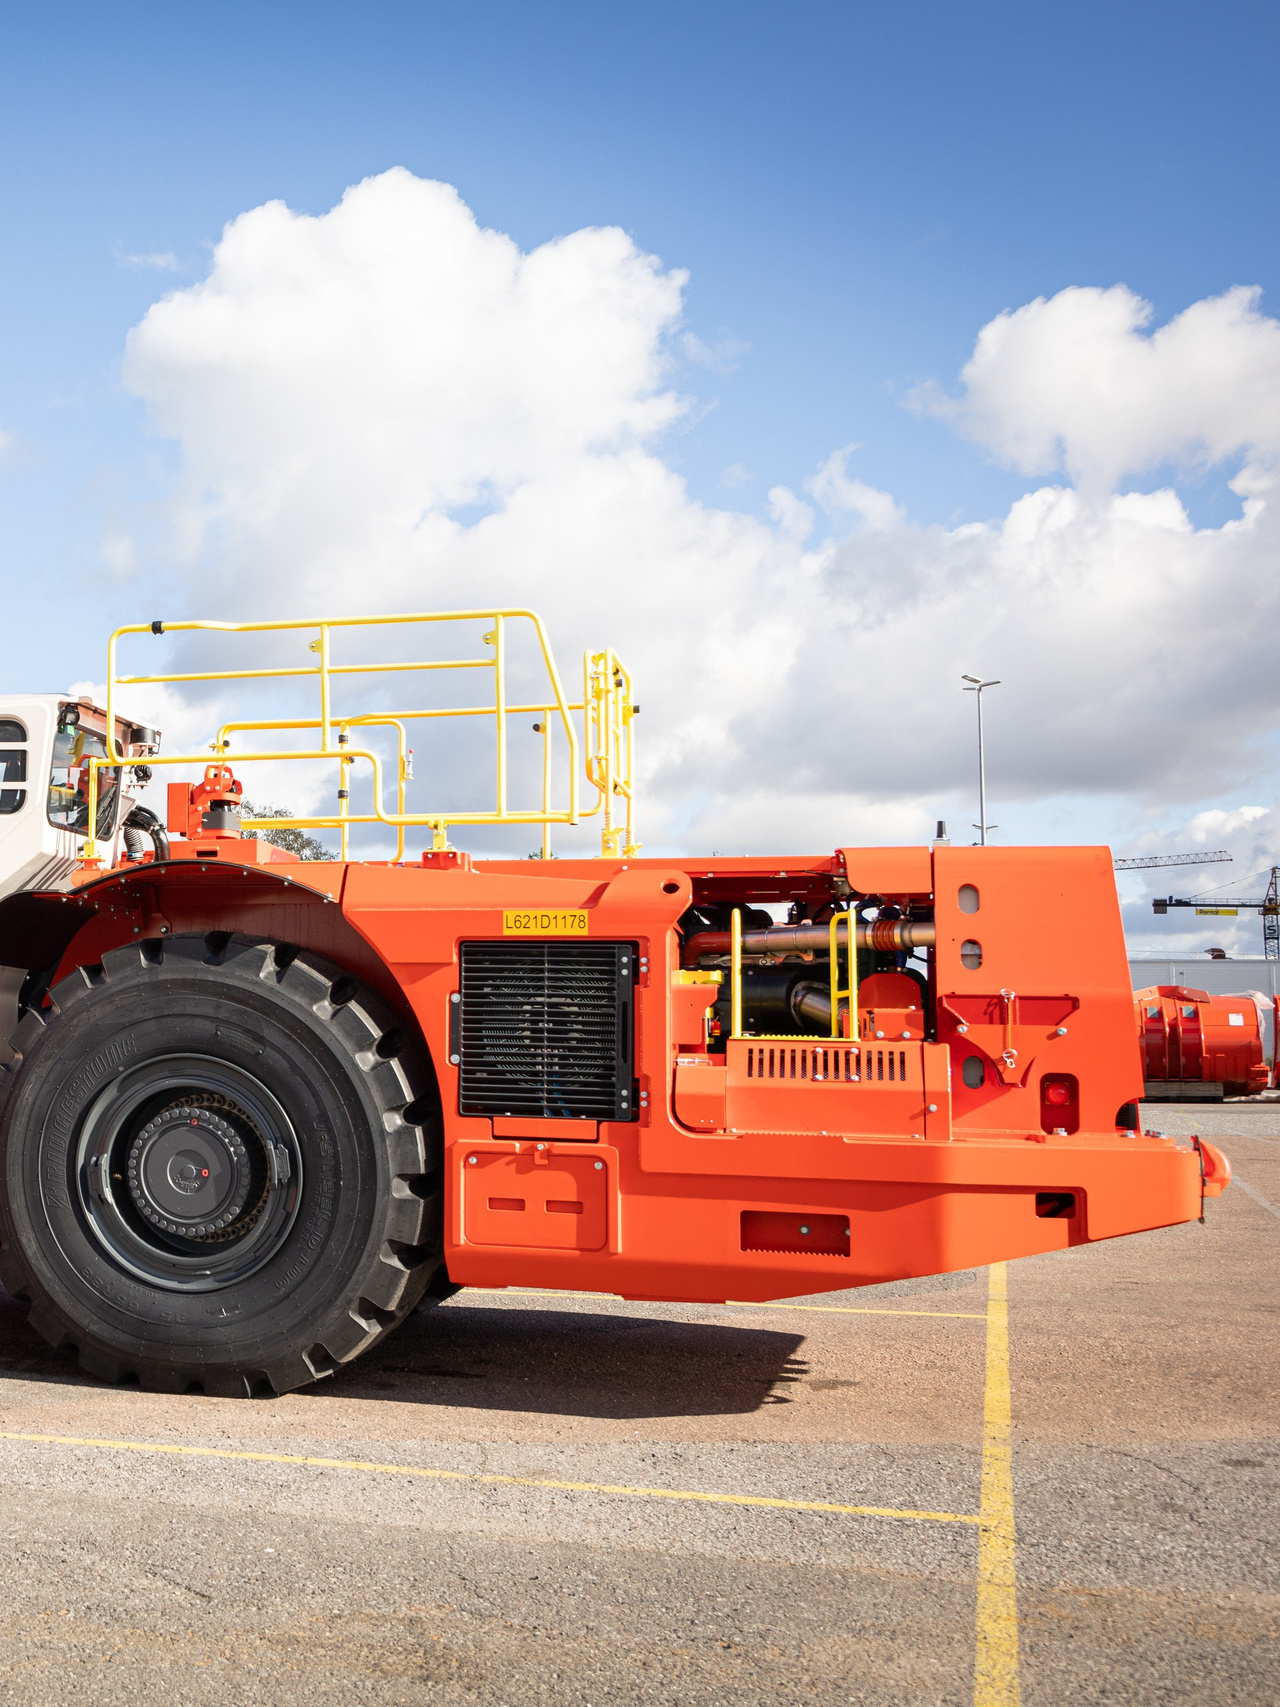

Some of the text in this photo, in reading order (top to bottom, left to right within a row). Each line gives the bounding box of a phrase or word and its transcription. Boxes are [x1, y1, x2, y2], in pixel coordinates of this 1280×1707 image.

[505, 914, 587, 929] L621D1178
[1267, 925, 1277, 935] S
[43, 1031, 138, 1211] BRIDGESTONE
